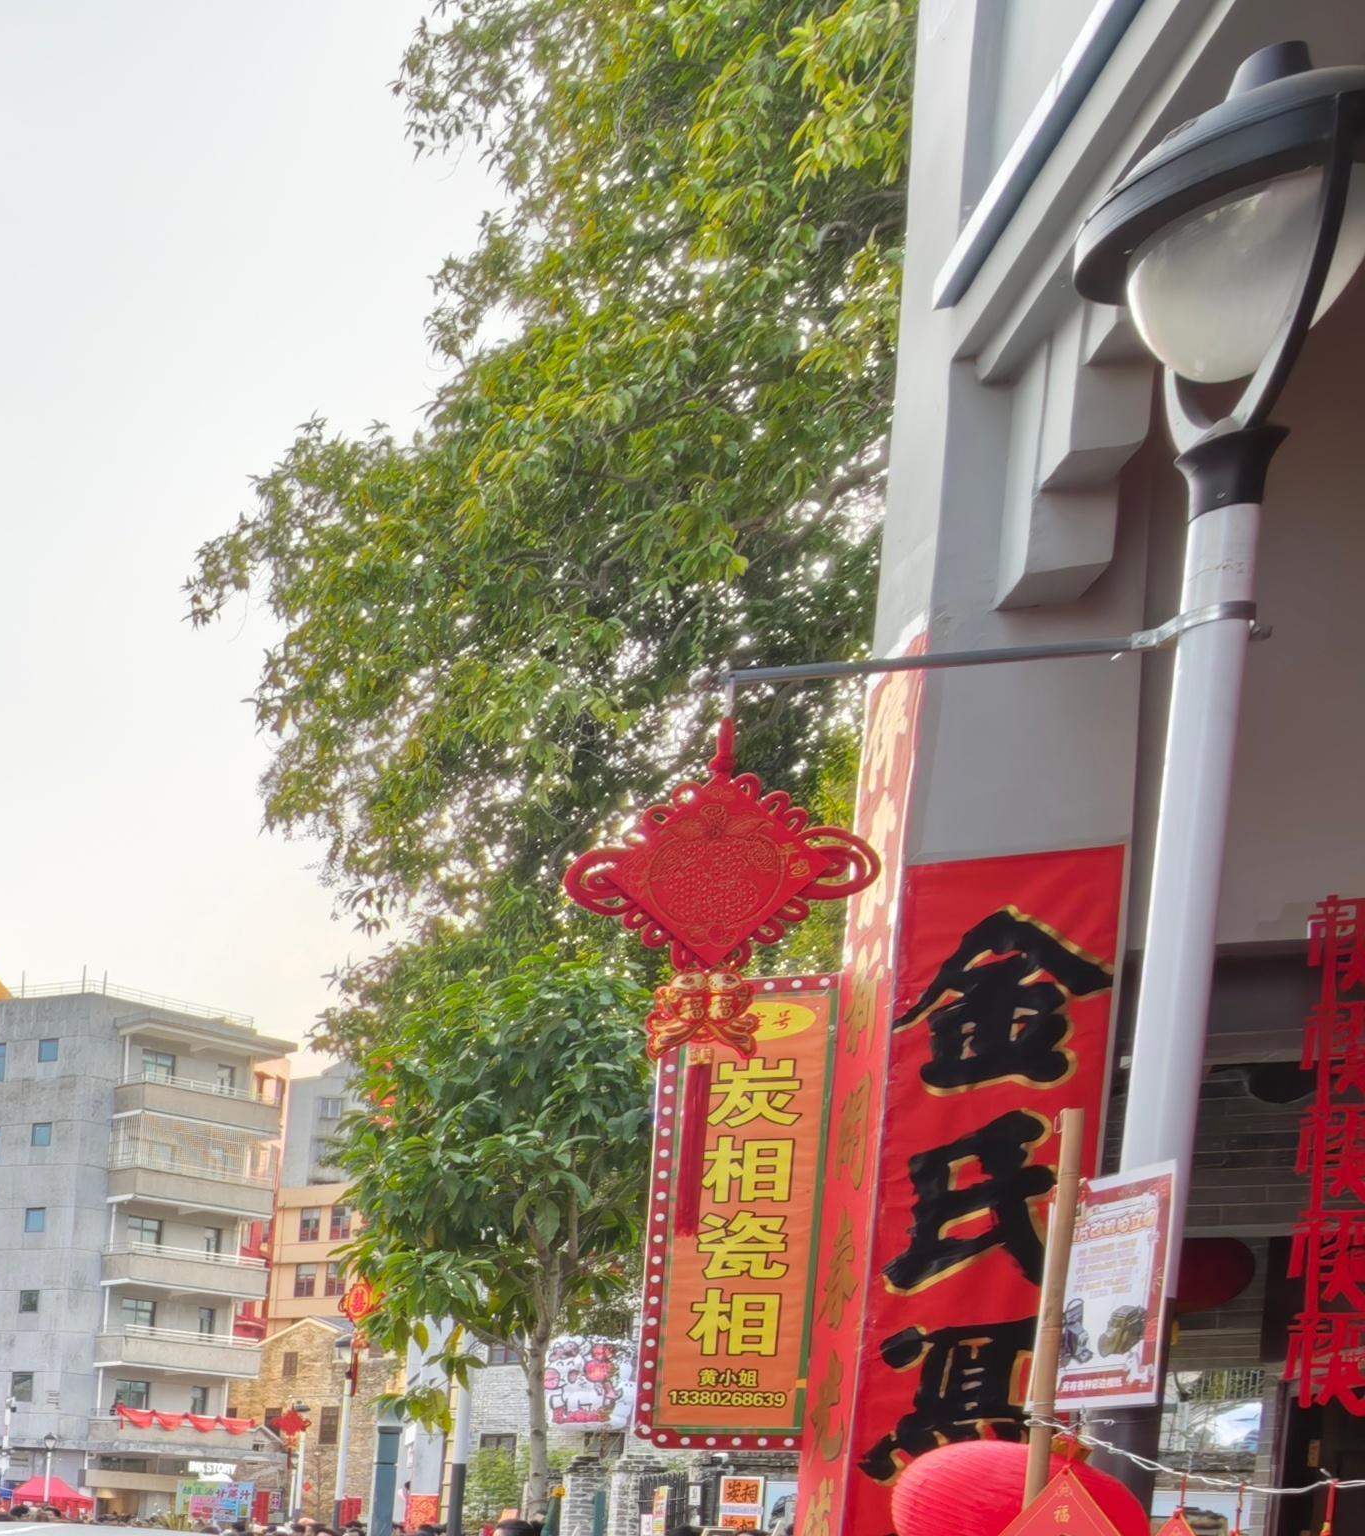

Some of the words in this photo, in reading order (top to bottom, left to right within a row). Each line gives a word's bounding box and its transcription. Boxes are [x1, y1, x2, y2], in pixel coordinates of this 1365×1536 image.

[686, 1056, 803, 1357] 炭相瓷相
[698, 1368, 758, 1388] 黄小姐
[668, 1390, 787, 1408] 13380268639
[188, 1461, 204, 1473] INK
[205, 1462, 237, 1476] STORY
[1053, 1504, 1071, 1523] 福
